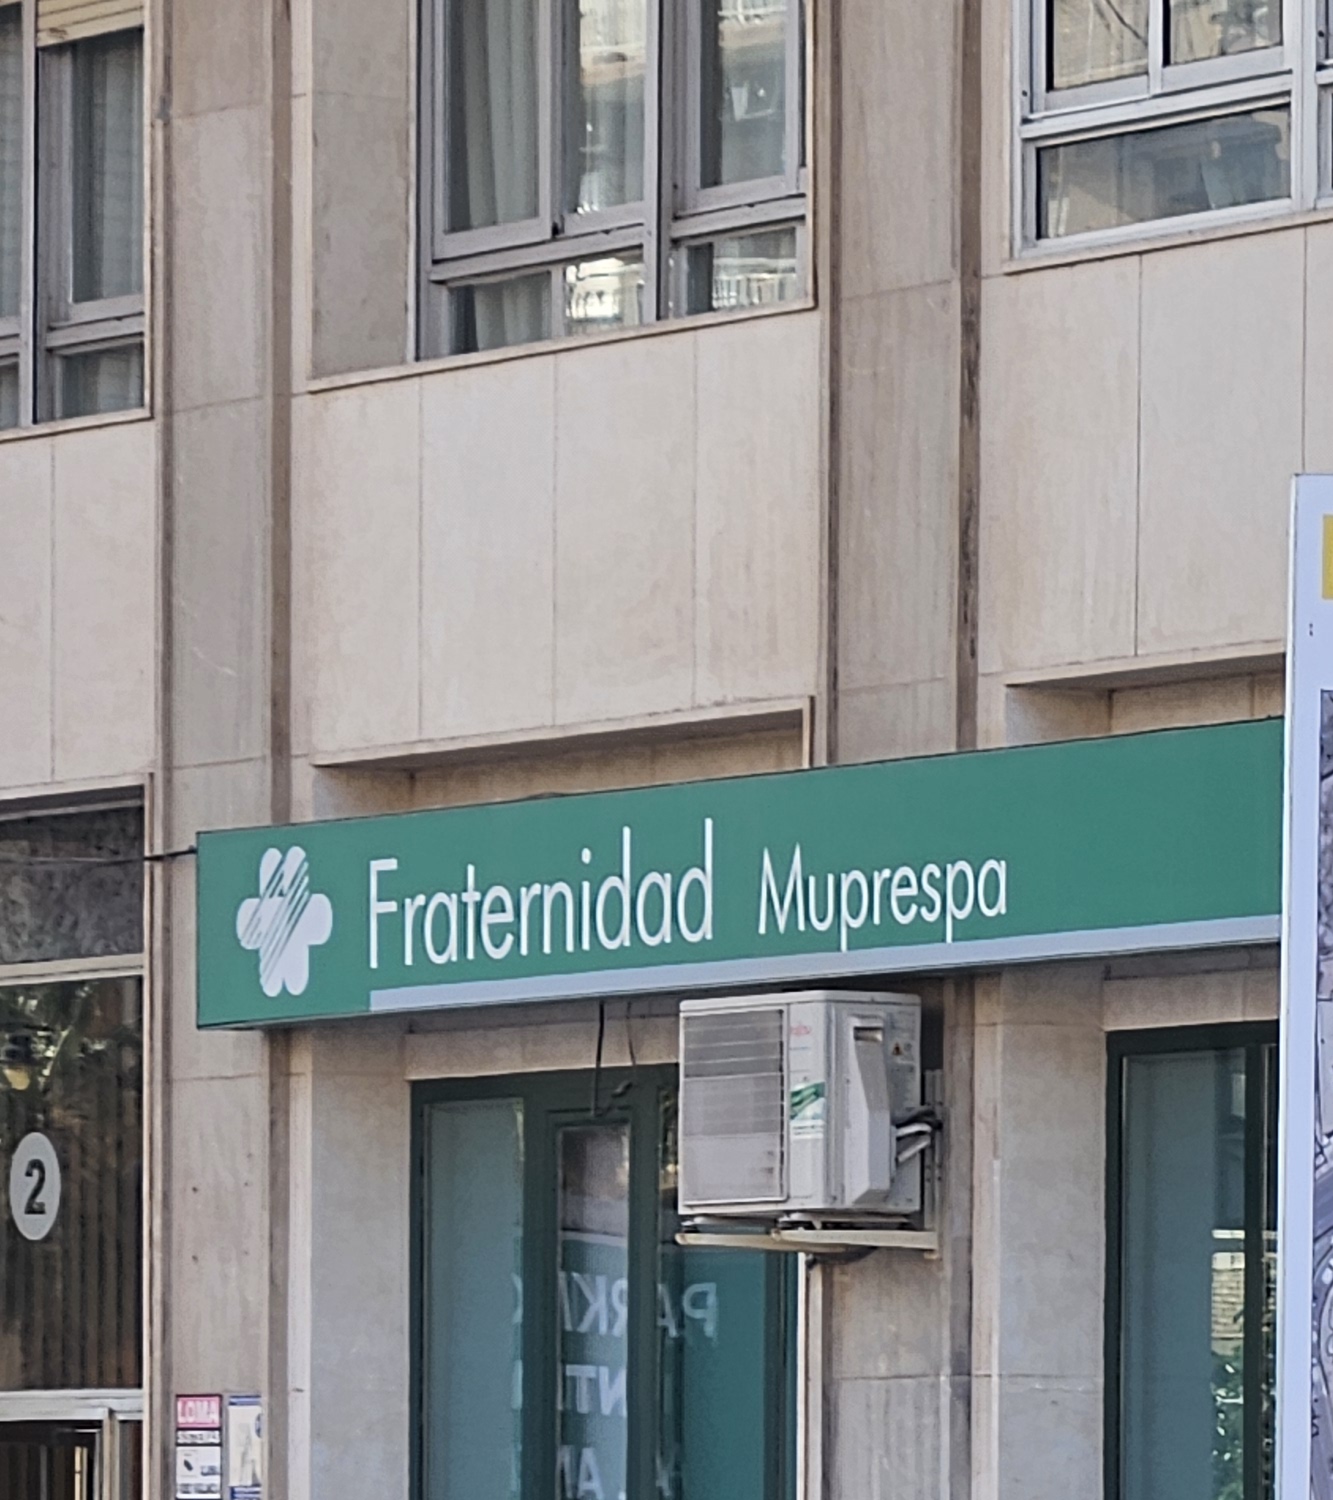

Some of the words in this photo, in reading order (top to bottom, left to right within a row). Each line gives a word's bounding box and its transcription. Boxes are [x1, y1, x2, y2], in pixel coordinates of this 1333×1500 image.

[368, 817, 714, 970] Fraternidad
[758, 842, 1007, 951] Muprespa
[24, 1159, 45, 1214] 2
